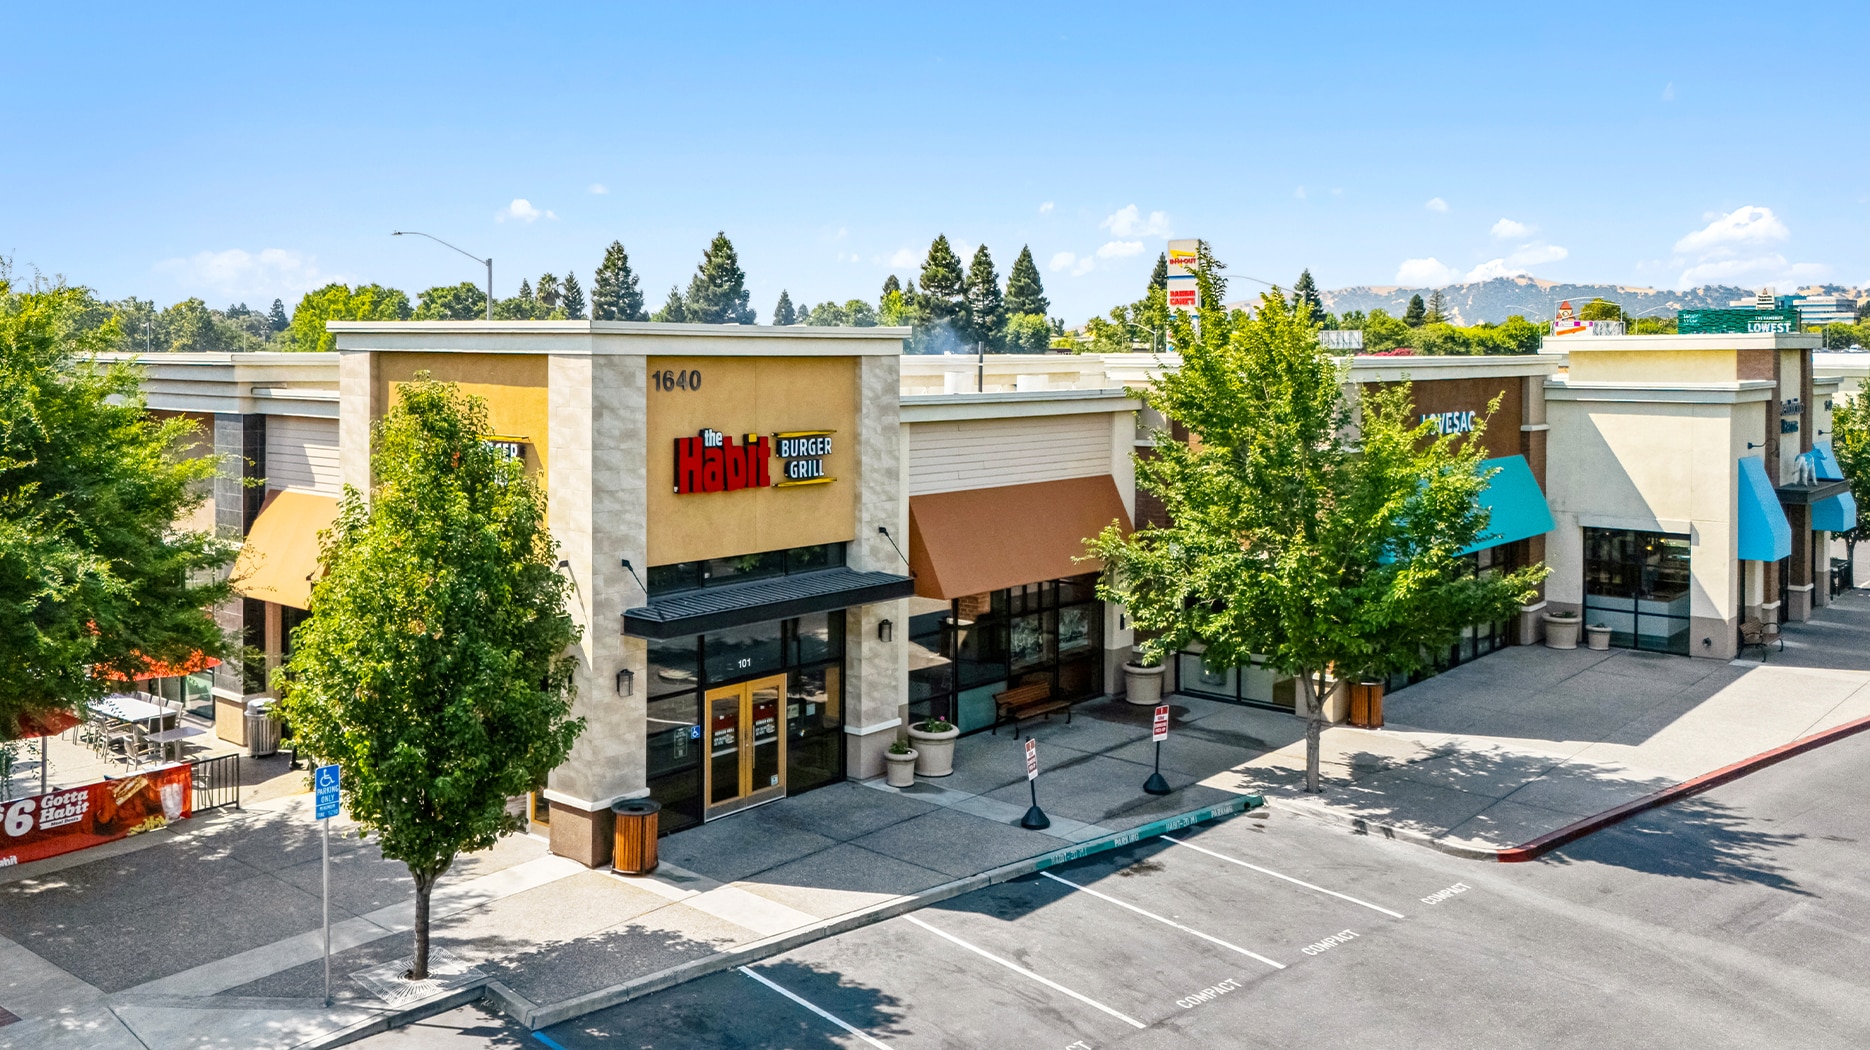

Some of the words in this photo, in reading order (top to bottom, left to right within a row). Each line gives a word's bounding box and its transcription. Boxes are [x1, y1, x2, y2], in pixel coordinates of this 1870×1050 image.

[1747, 323, 1791, 333] LOWEST
[652, 369, 702, 392] 1640
[1421, 411, 1476, 435] VESAC
[702, 428, 723, 447] the
[781, 437, 833, 458] BURGER
[674, 433, 771, 495] Habit
[789, 458, 825, 478] GRILL
[738, 658, 751, 668] 101
[41, 790, 89, 809] Gotta
[317, 785, 339, 795] PARKING
[321, 794, 335, 803] ONLY
[39, 801, 90, 823] Habit
[1210, 806, 1233, 818] PARKING
[1114, 833, 1139, 848] PARKING
[1420, 883, 1472, 905] COMPACT
[1301, 929, 1360, 955] COMPACT
[1176, 978, 1242, 1008] COMPACT
